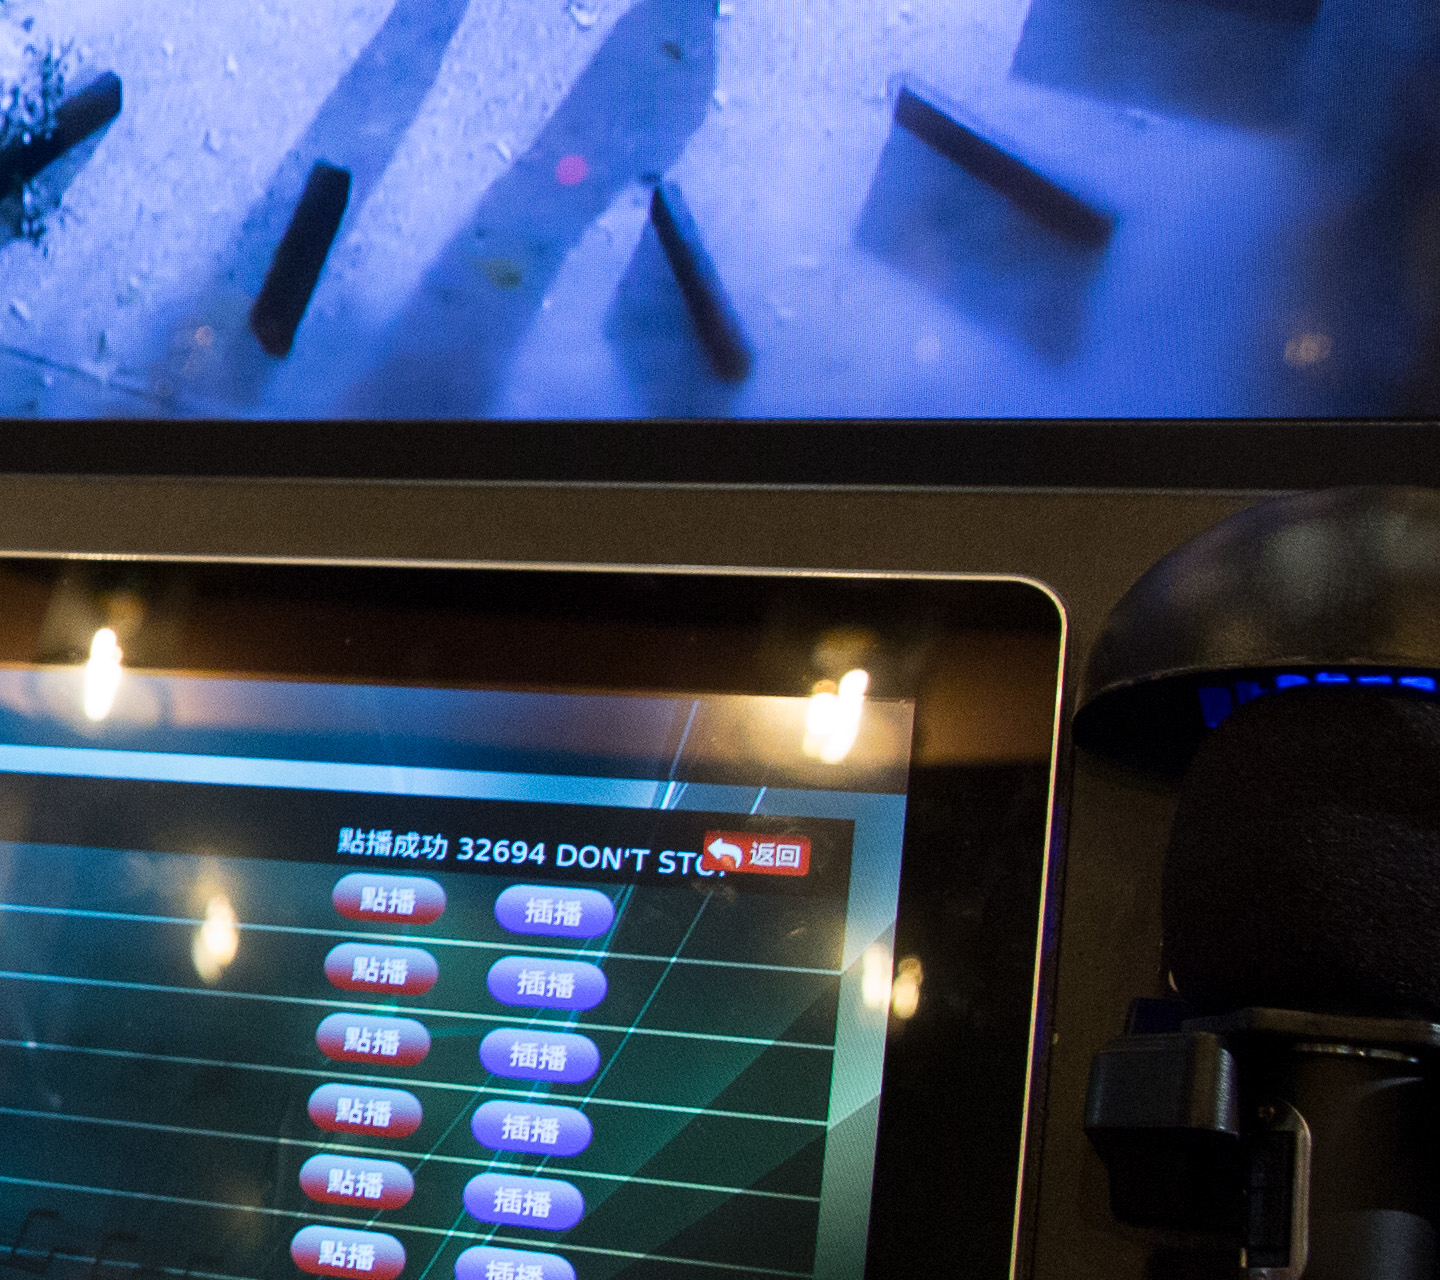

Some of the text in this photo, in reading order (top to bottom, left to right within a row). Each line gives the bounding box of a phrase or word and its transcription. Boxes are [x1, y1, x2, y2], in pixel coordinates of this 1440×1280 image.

[337, 826, 449, 861] 點播成功
[457, 837, 547, 866] 32694
[556, 843, 650, 874] DON'T
[748, 840, 802, 870] 返回
[359, 886, 416, 915] 點播
[525, 897, 582, 927] 插播
[351, 956, 408, 985] 點播
[517, 968, 575, 999] 插播
[343, 1026, 400, 1056] 點播
[510, 1040, 567, 1071] 插播
[335, 1096, 392, 1126] 點播
[501, 1113, 559, 1144] 插播
[326, 1167, 384, 1198] 點播
[494, 1186, 551, 1218] 插播
[318, 1239, 376, 1271] 點播
